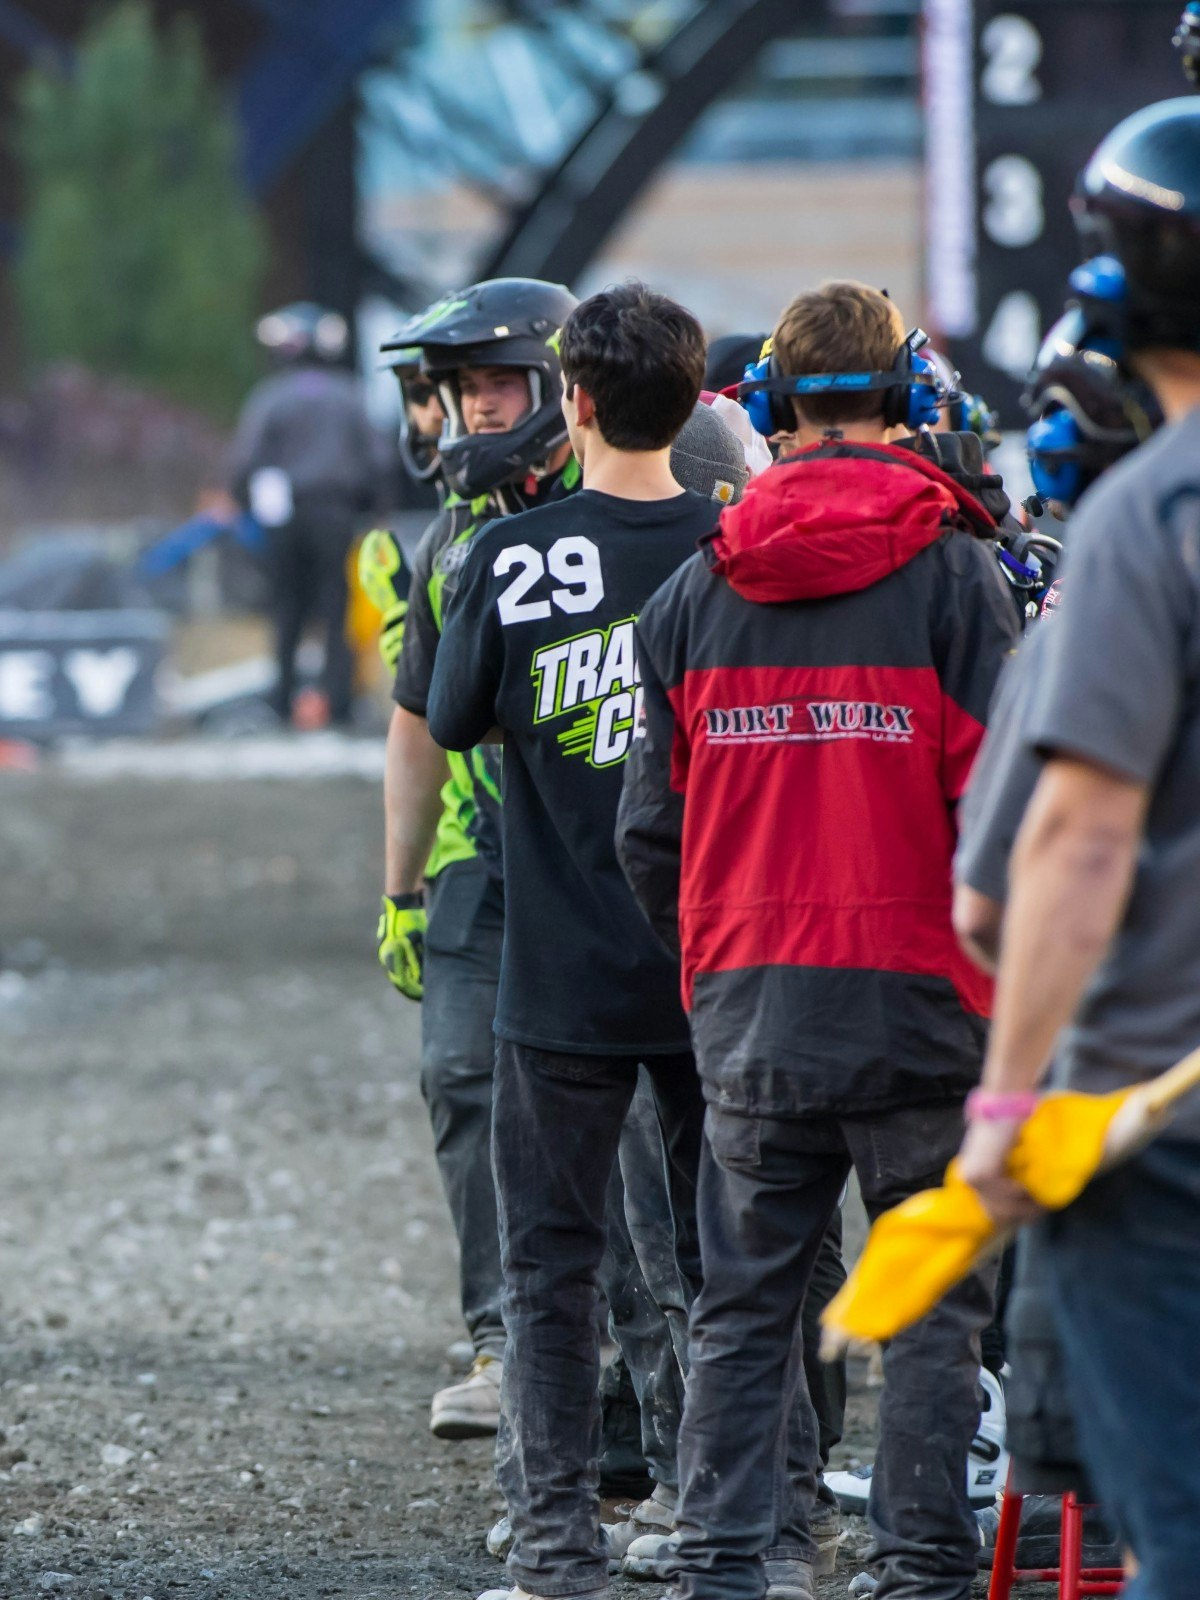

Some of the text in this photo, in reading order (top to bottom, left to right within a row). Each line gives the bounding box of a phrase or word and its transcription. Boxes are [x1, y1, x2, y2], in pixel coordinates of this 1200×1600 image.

[492, 535, 605, 626] 29
[534, 620, 642, 719] TRA
[704, 701, 915, 736] DIRT WURX
